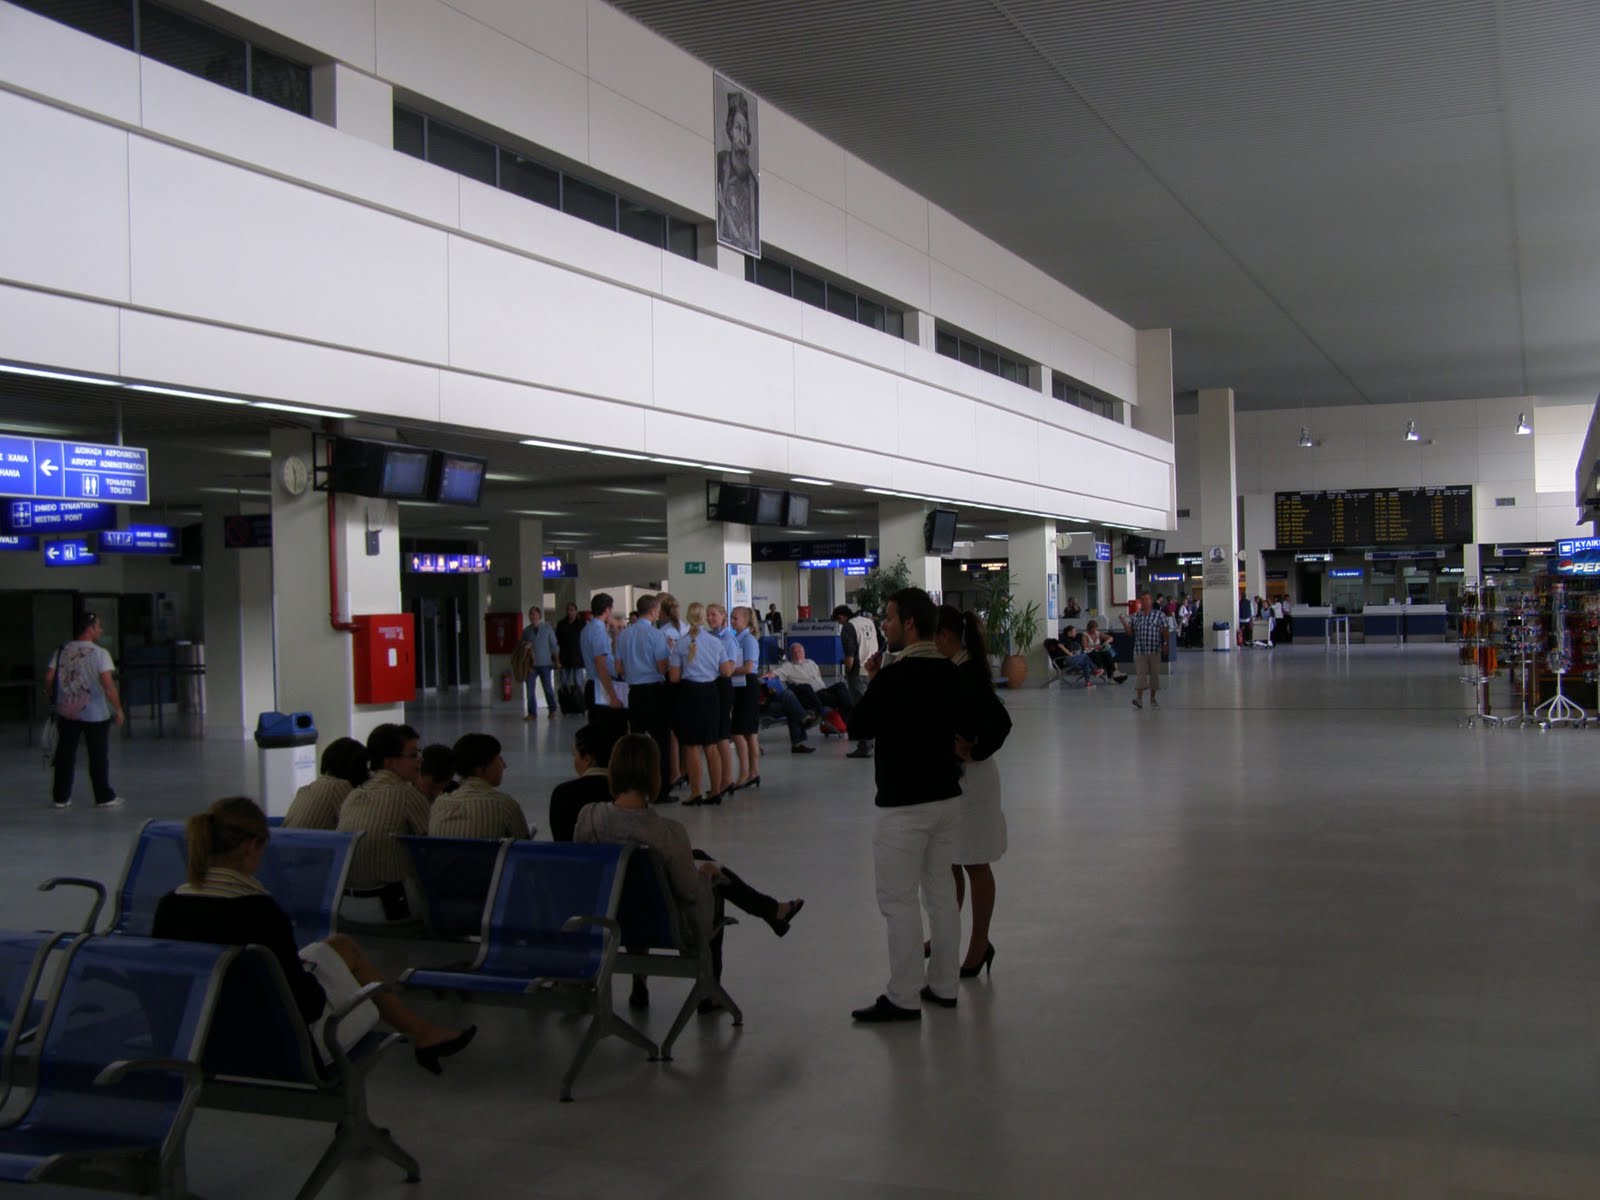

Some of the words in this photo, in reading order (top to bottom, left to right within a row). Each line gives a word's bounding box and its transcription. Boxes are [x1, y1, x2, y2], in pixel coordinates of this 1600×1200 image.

[71, 458, 97, 466] AIRPORT
[100, 460, 145, 470] ADMINISTRATION
[34, 515, 61, 524] MEETING
[64, 513, 83, 522] POINT
